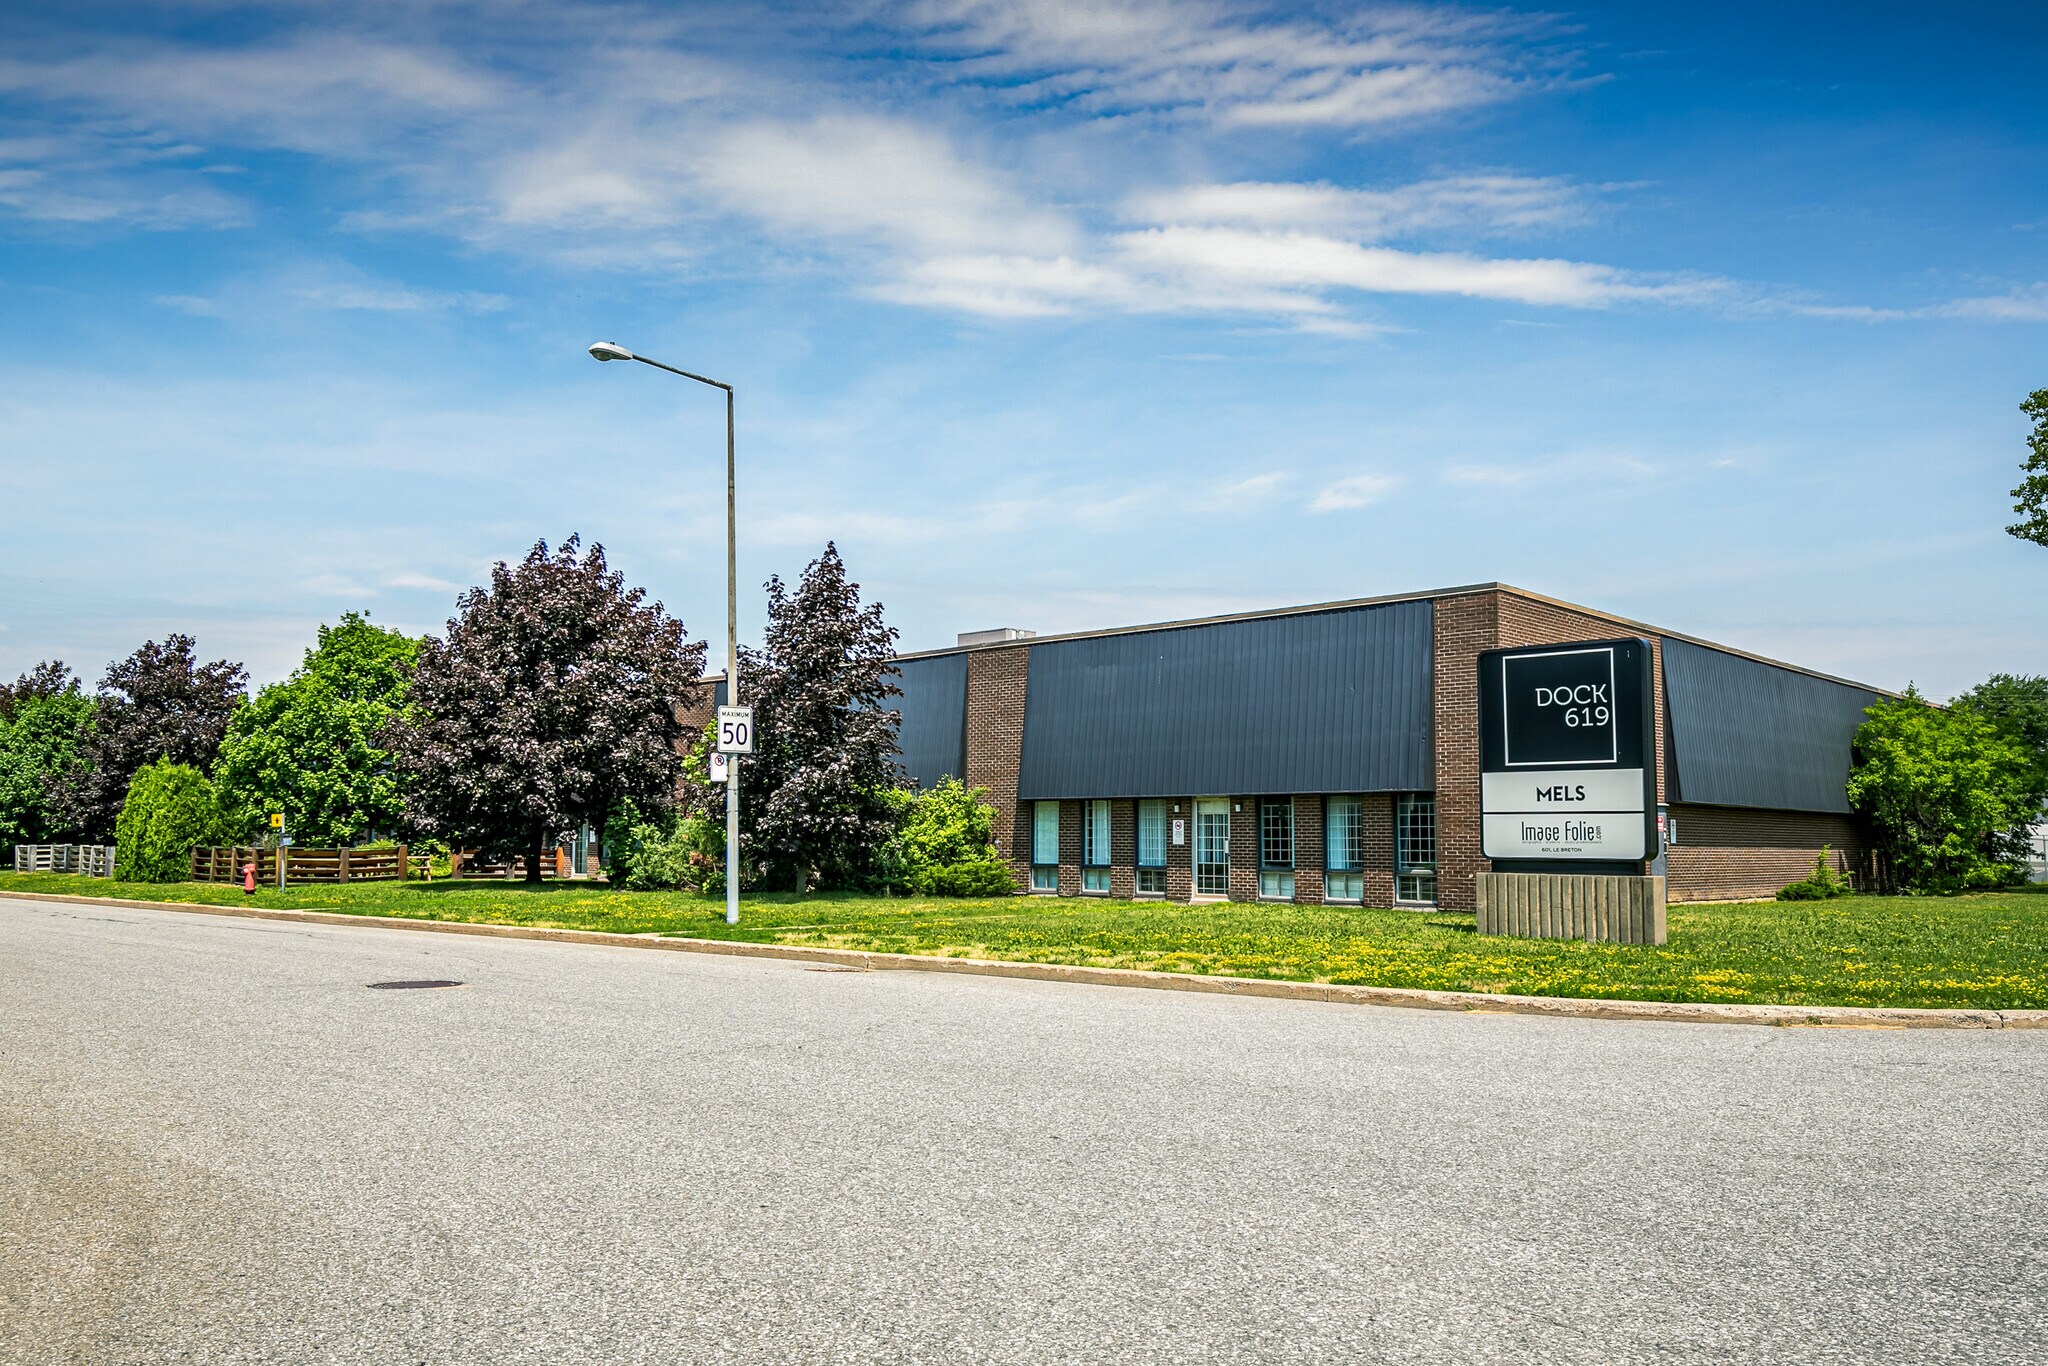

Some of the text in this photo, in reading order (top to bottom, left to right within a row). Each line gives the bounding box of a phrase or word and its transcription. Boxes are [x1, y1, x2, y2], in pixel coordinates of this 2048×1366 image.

[1535, 684, 1608, 706] DOCK
[1565, 706, 1609, 727] 619
[723, 723, 747, 745] 50
[1536, 785, 1586, 802] MELS
[1521, 821, 1560, 841] Image
